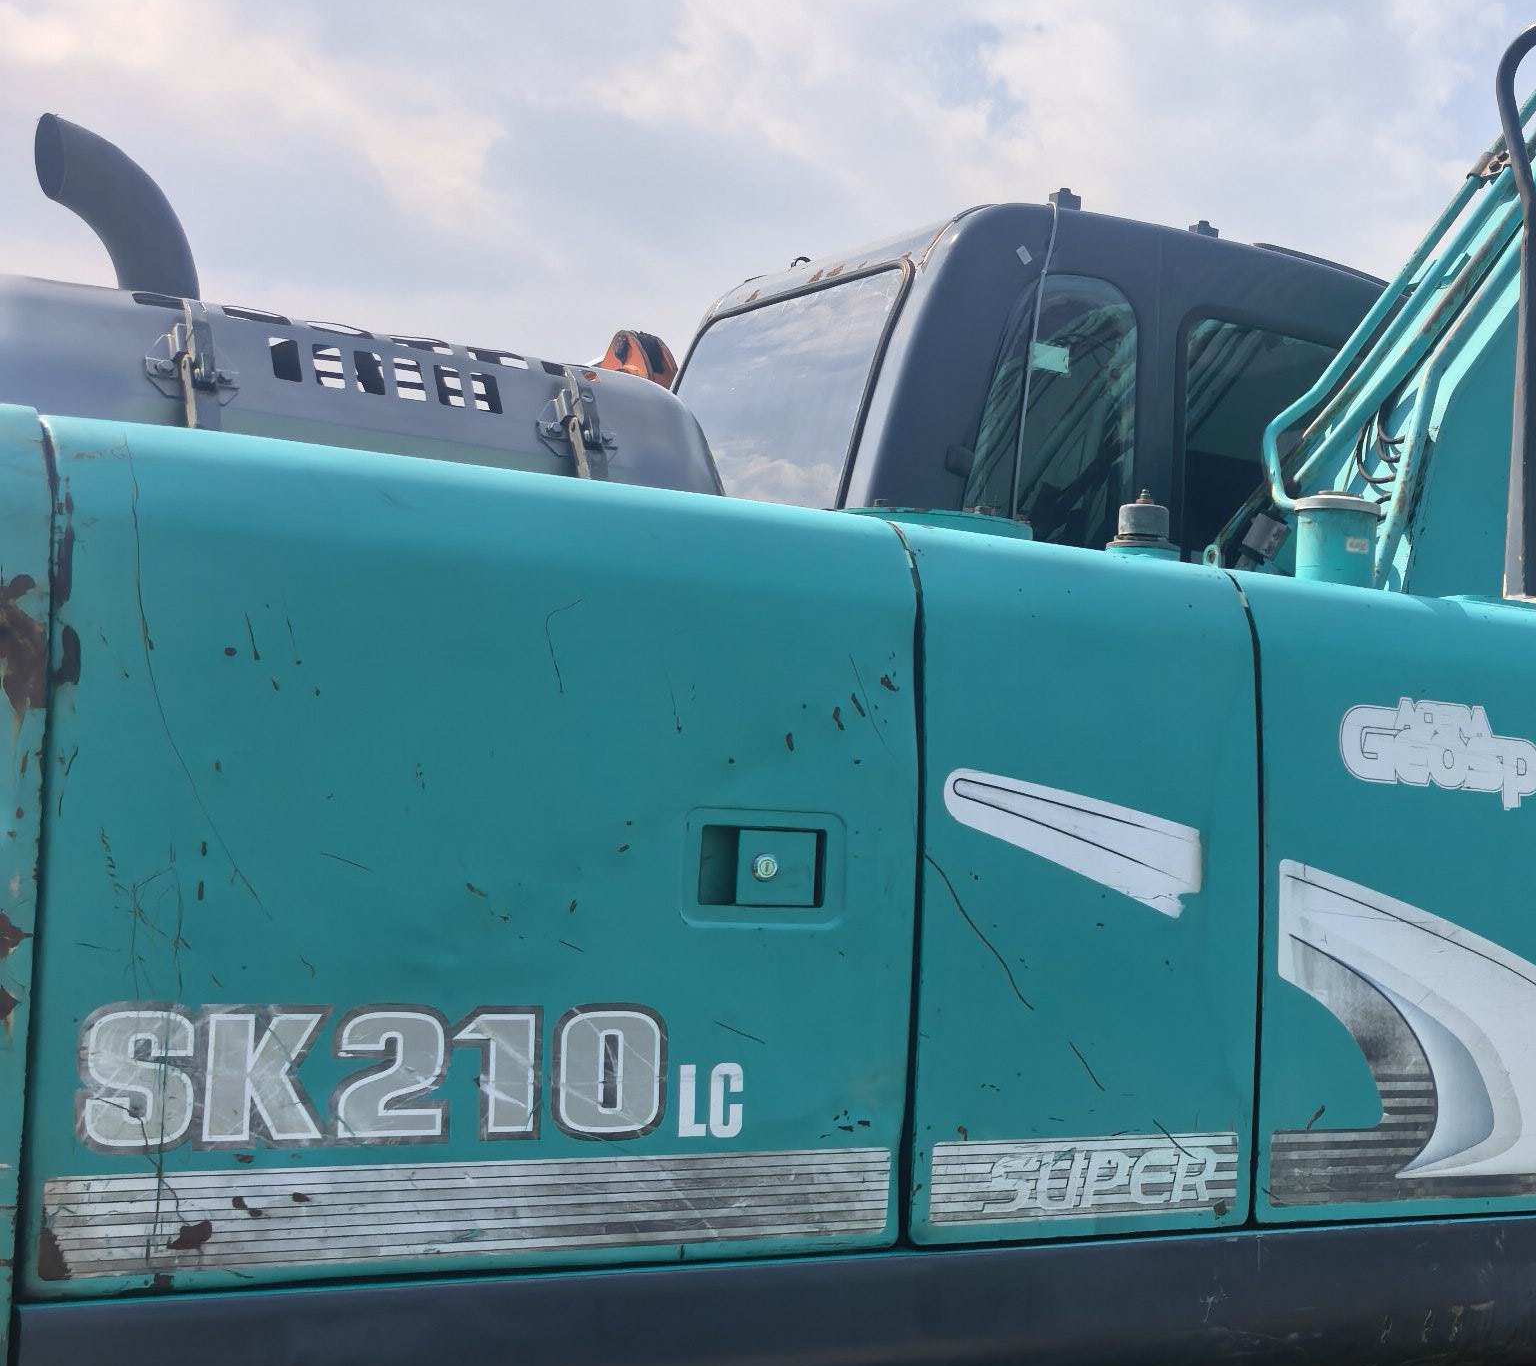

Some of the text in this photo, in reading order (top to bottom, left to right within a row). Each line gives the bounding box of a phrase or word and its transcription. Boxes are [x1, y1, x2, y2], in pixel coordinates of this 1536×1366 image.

[76, 1001, 744, 1155] SK210 LC
[982, 1147, 1218, 1213] SUPER
